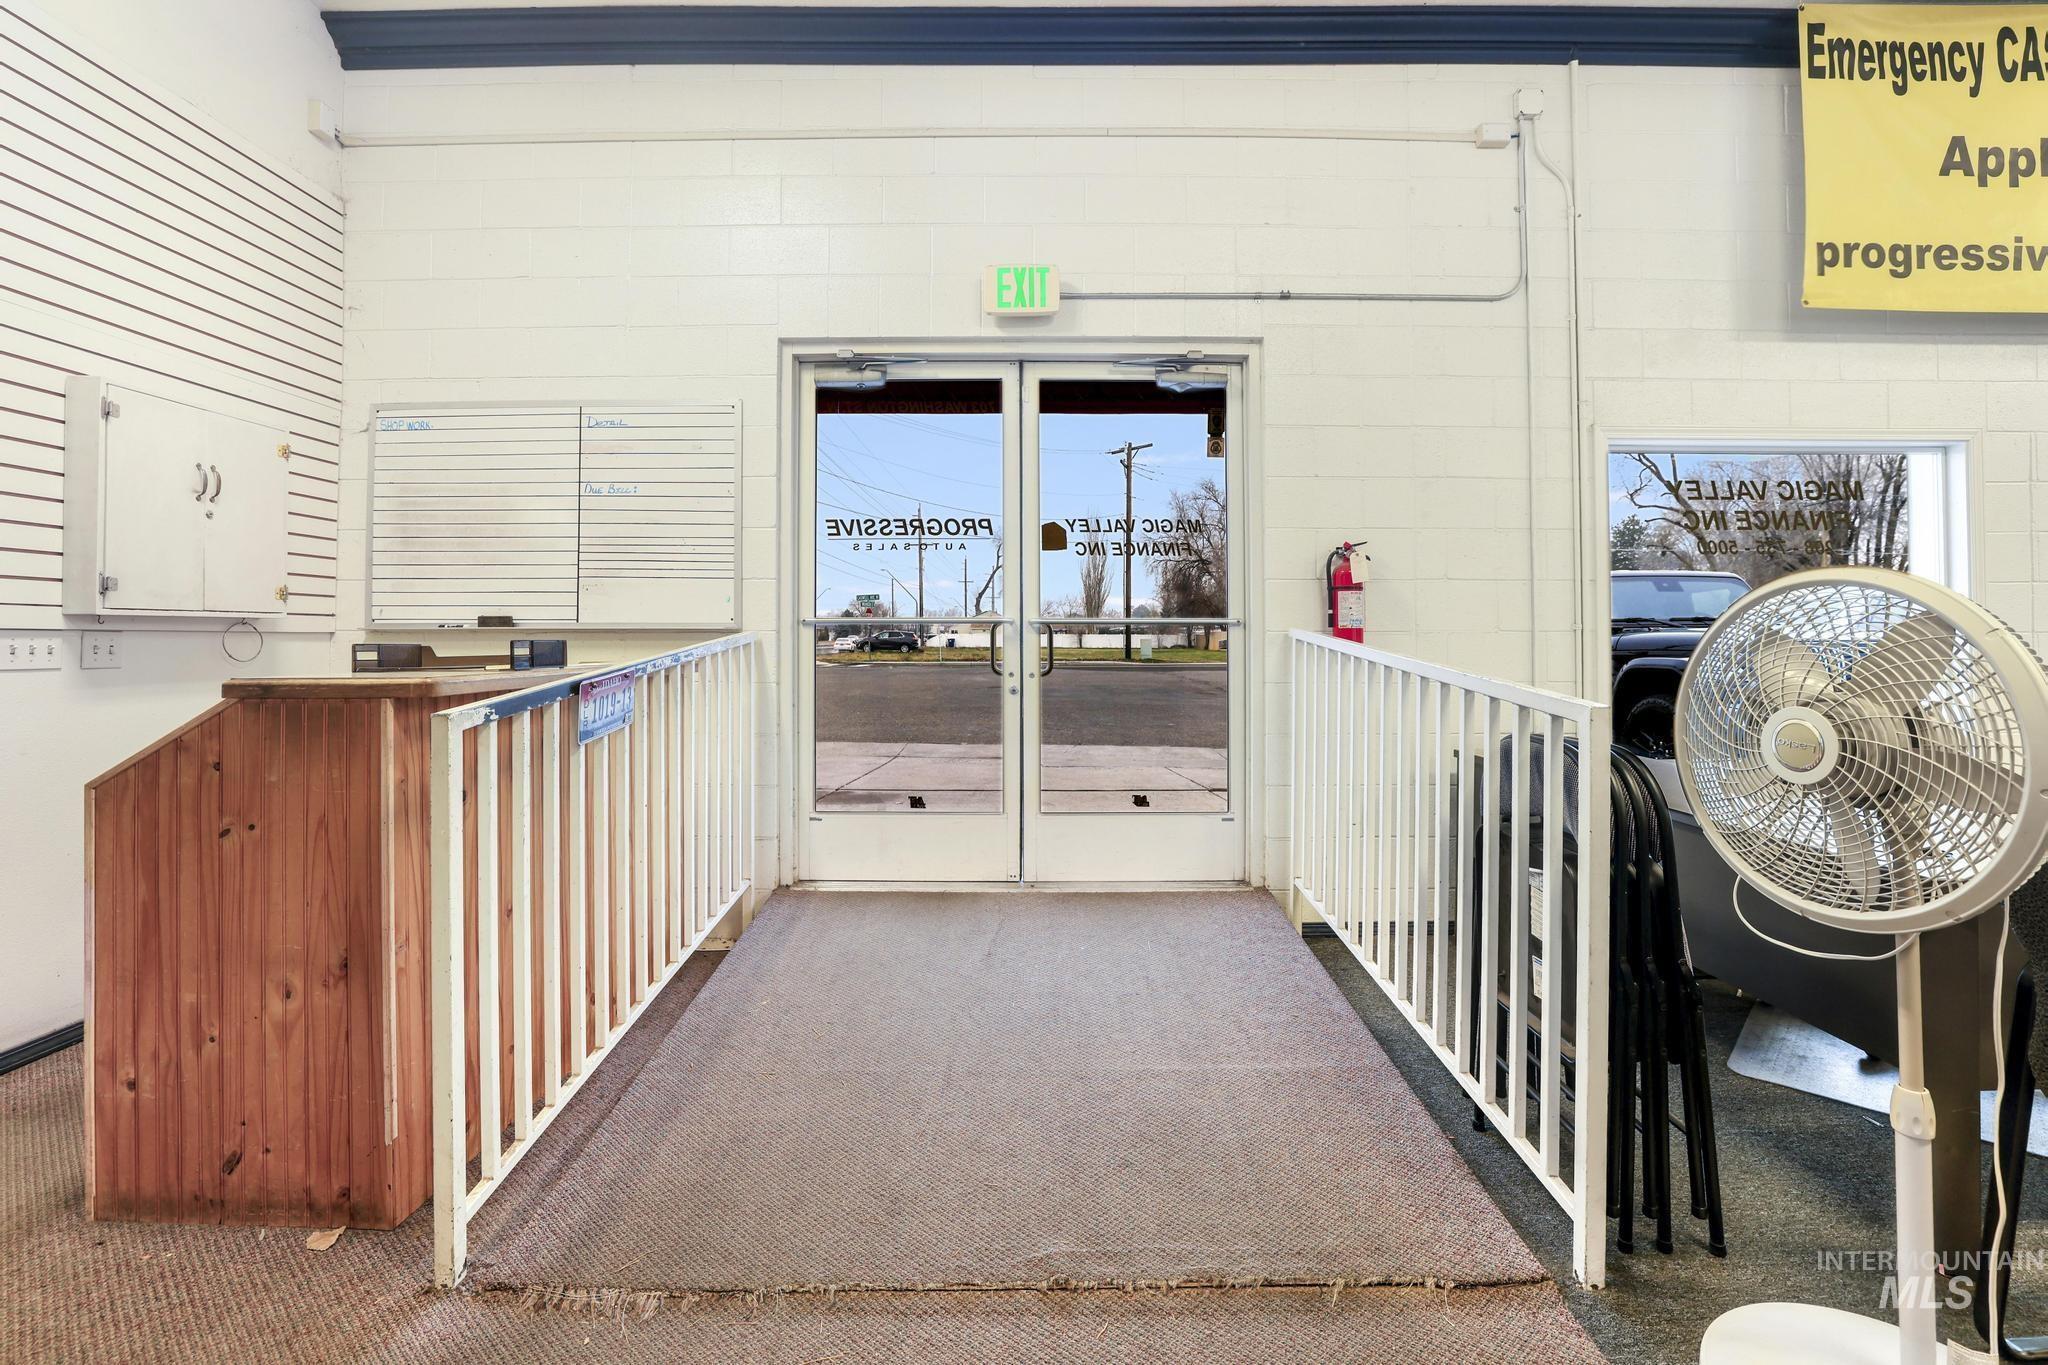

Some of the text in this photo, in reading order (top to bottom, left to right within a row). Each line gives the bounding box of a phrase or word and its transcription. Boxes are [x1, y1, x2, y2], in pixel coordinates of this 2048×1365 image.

[1807, 22, 2048, 98] Emergency CA
[997, 267, 1050, 308] EXIT
[380, 419, 404, 432] SHOP
[592, 686, 632, 724] 1019-13
